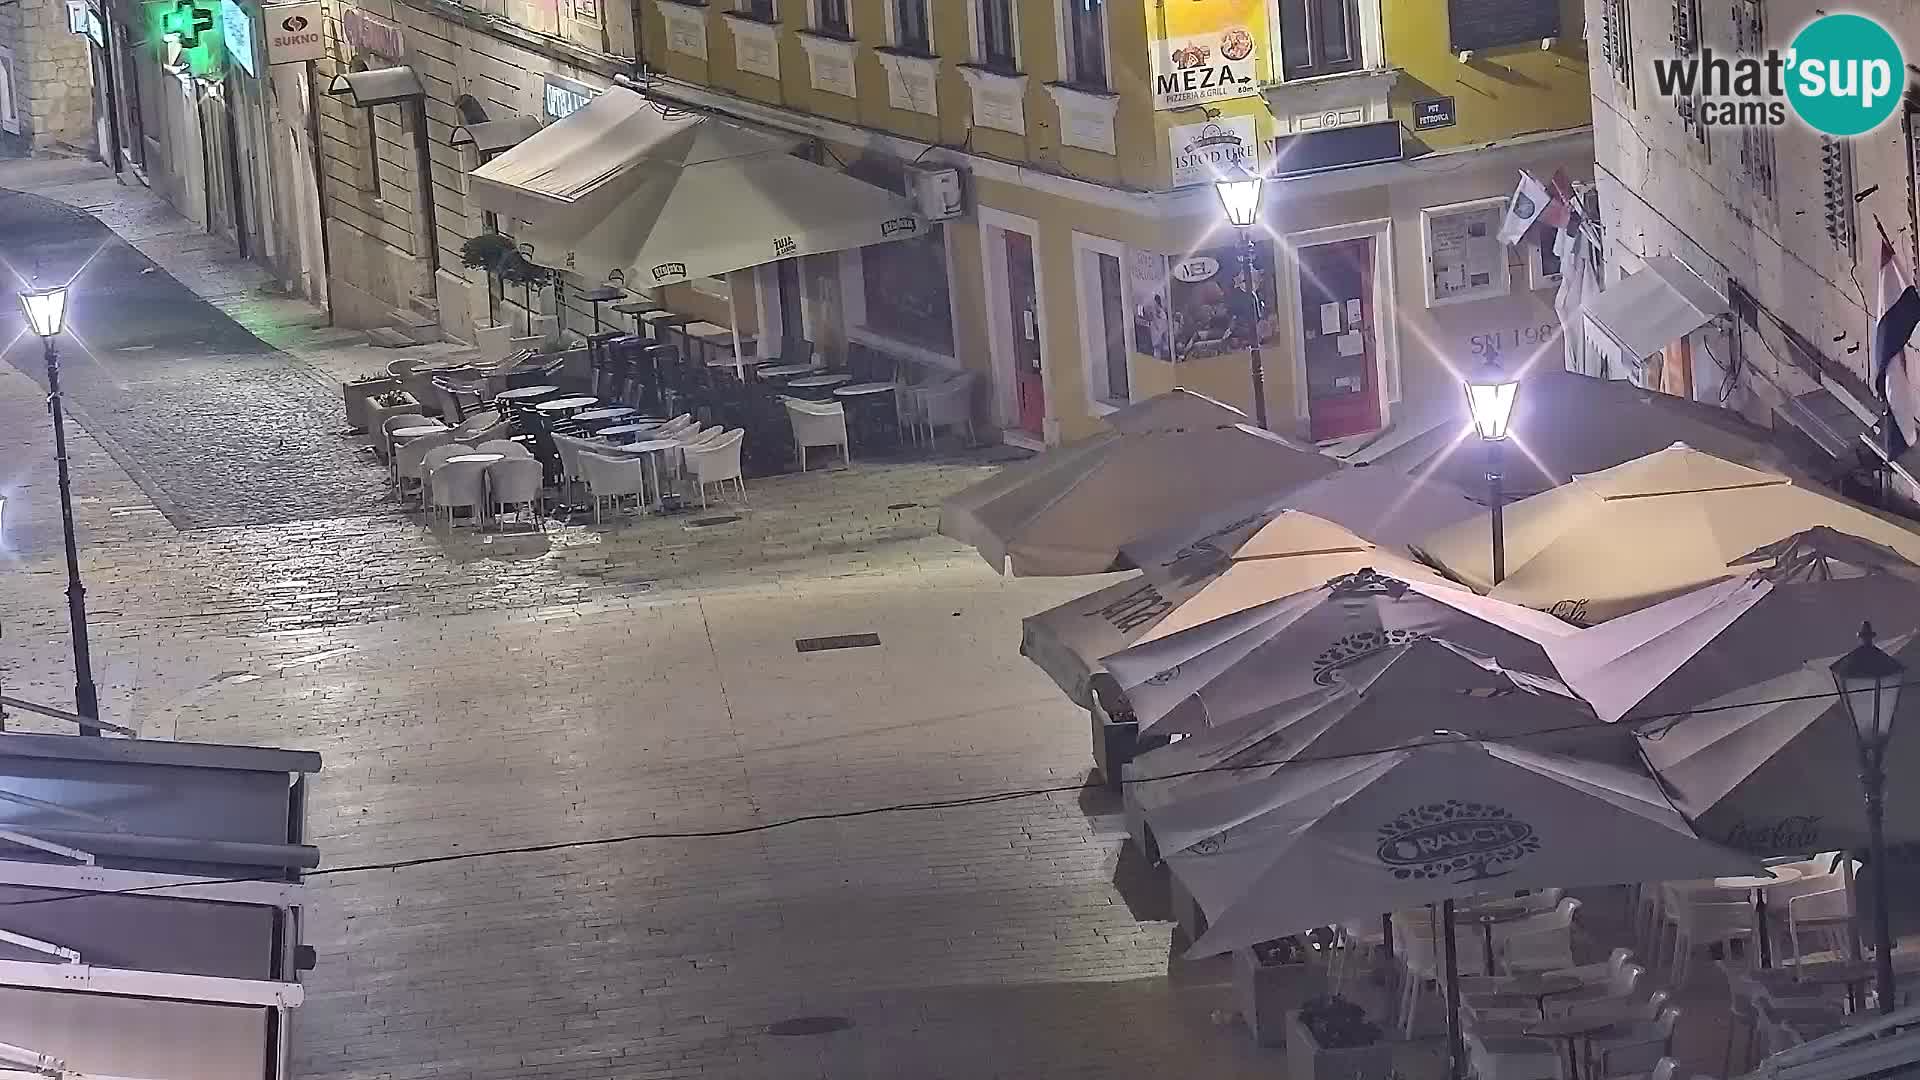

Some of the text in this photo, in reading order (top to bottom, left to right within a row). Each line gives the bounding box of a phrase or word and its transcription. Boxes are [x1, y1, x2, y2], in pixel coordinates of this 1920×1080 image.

[273, 33, 319, 47] SUKNO
[1157, 65, 1236, 95] MEZA
[1166, 87, 1227, 103] PIZZERIA & GRILL
[1175, 150, 1221, 169] ISPOD
[774, 235, 793, 251] ŽUJA
